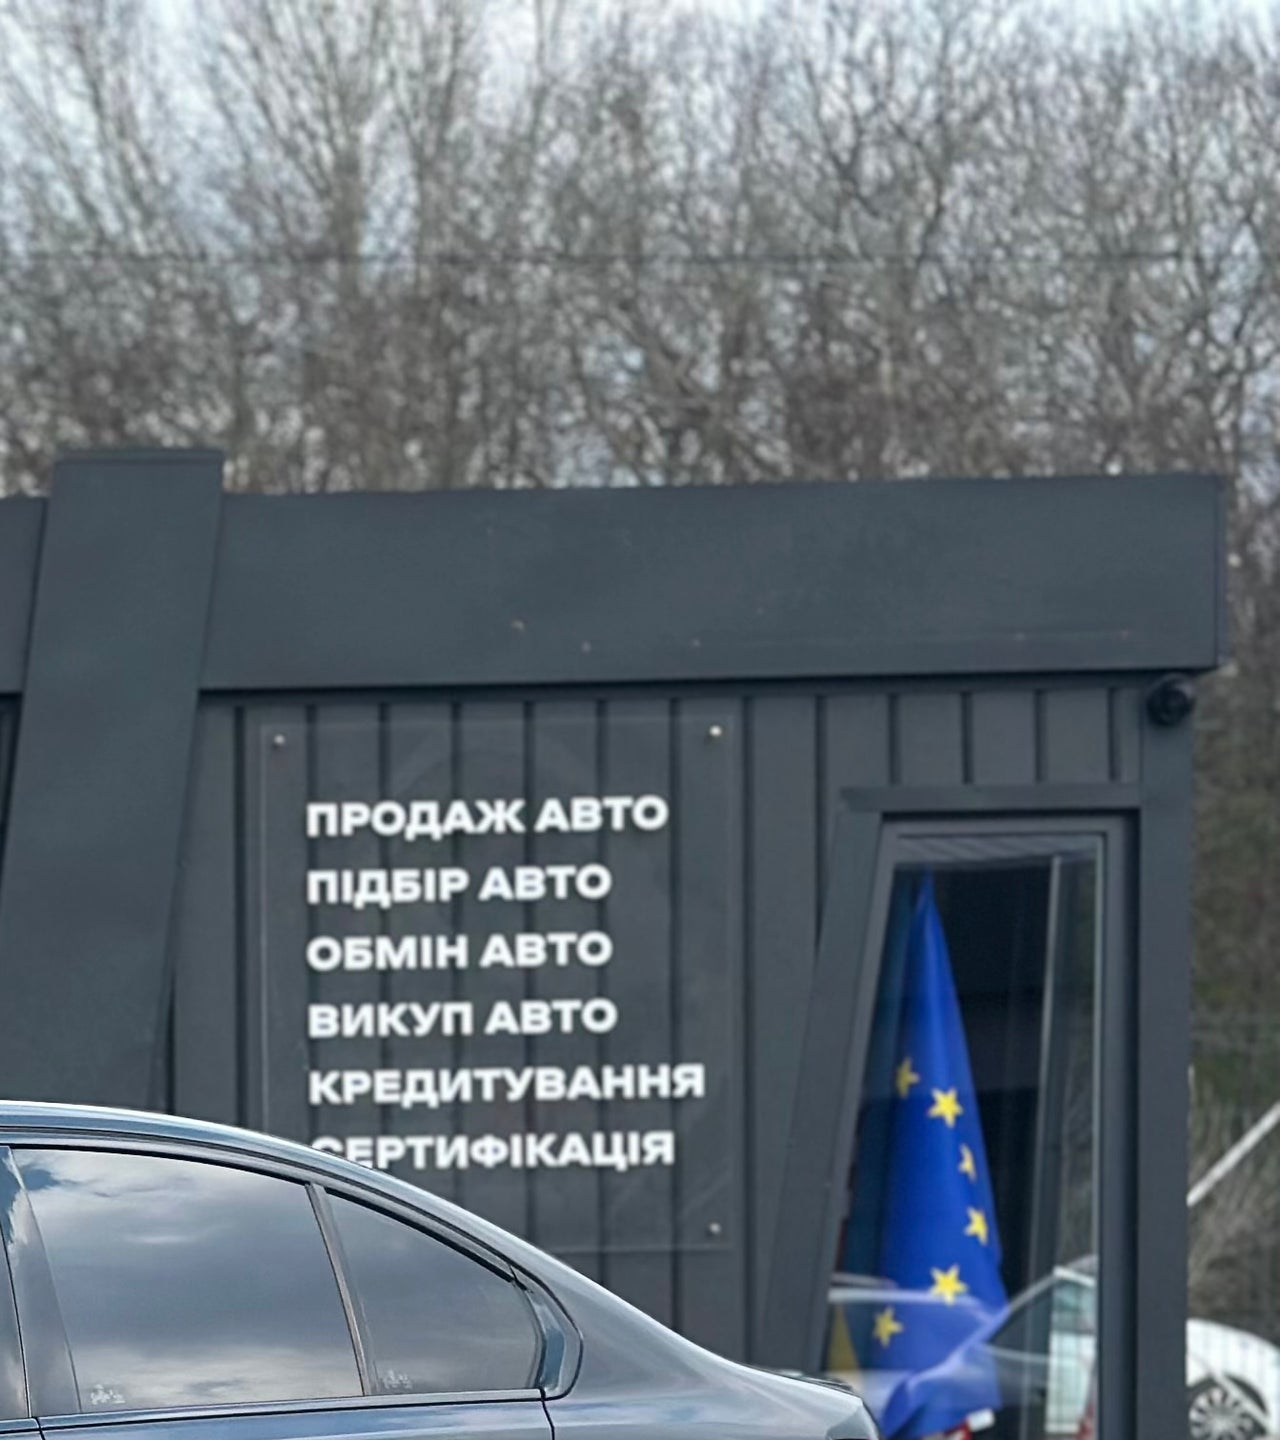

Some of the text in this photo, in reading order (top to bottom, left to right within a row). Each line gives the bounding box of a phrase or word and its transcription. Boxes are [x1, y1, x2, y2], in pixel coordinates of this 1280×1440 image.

[306, 795, 669, 841] ПРОДАЖ АВТО
[306, 863, 612, 910] ПІДБІР АВТО
[306, 931, 613, 971] ОБМІН АВТО
[308, 998, 618, 1038] ВИКУП АВТО
[308, 1063, 706, 1109] КРЕДИТУВАННЯ
